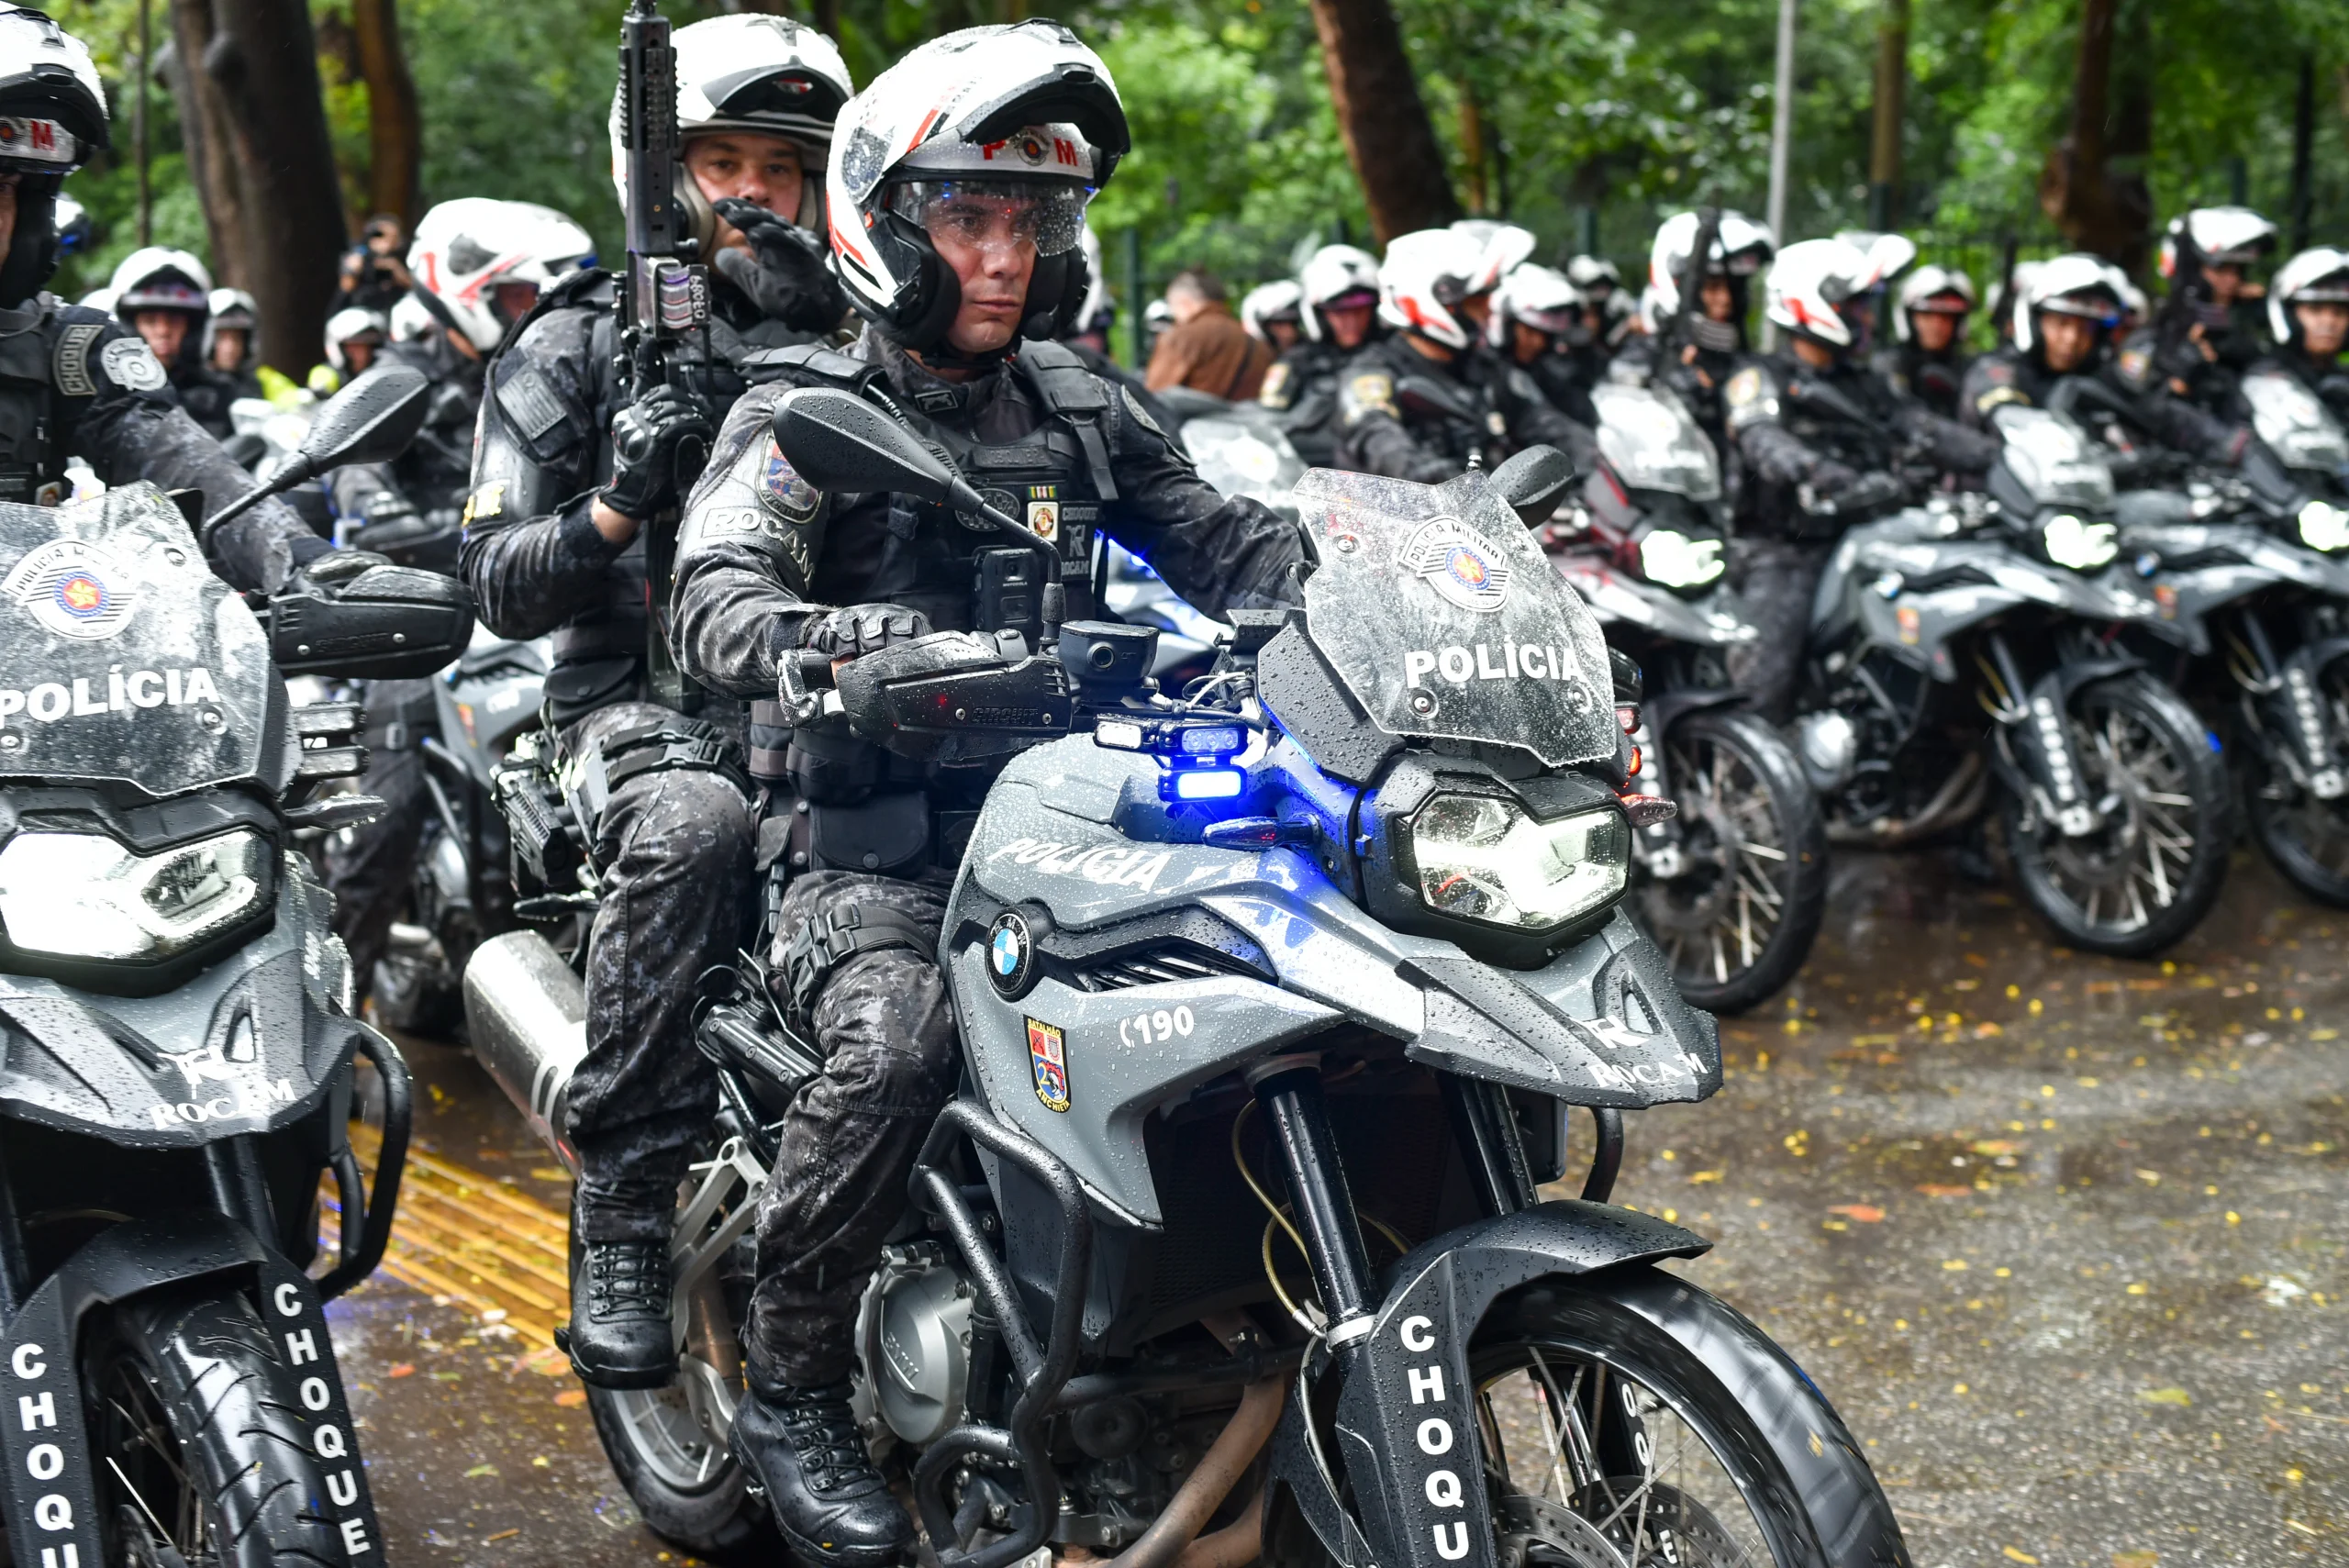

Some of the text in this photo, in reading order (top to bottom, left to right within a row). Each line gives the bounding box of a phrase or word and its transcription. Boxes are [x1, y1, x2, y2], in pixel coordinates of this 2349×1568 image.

[1053, 138, 1078, 166] M
[1404, 635, 1586, 688] POLÍCIA
[0, 664, 220, 729] POLÍCIA
[994, 917, 1027, 946] BMW
[1133, 1005, 1195, 1044] 190
[1587, 1052, 1709, 1088] ROCAM
[148, 1079, 299, 1130] ROCM
[1036, 1088, 1071, 1112] ANCHIETA
[274, 1283, 370, 1556] CHOQUE
